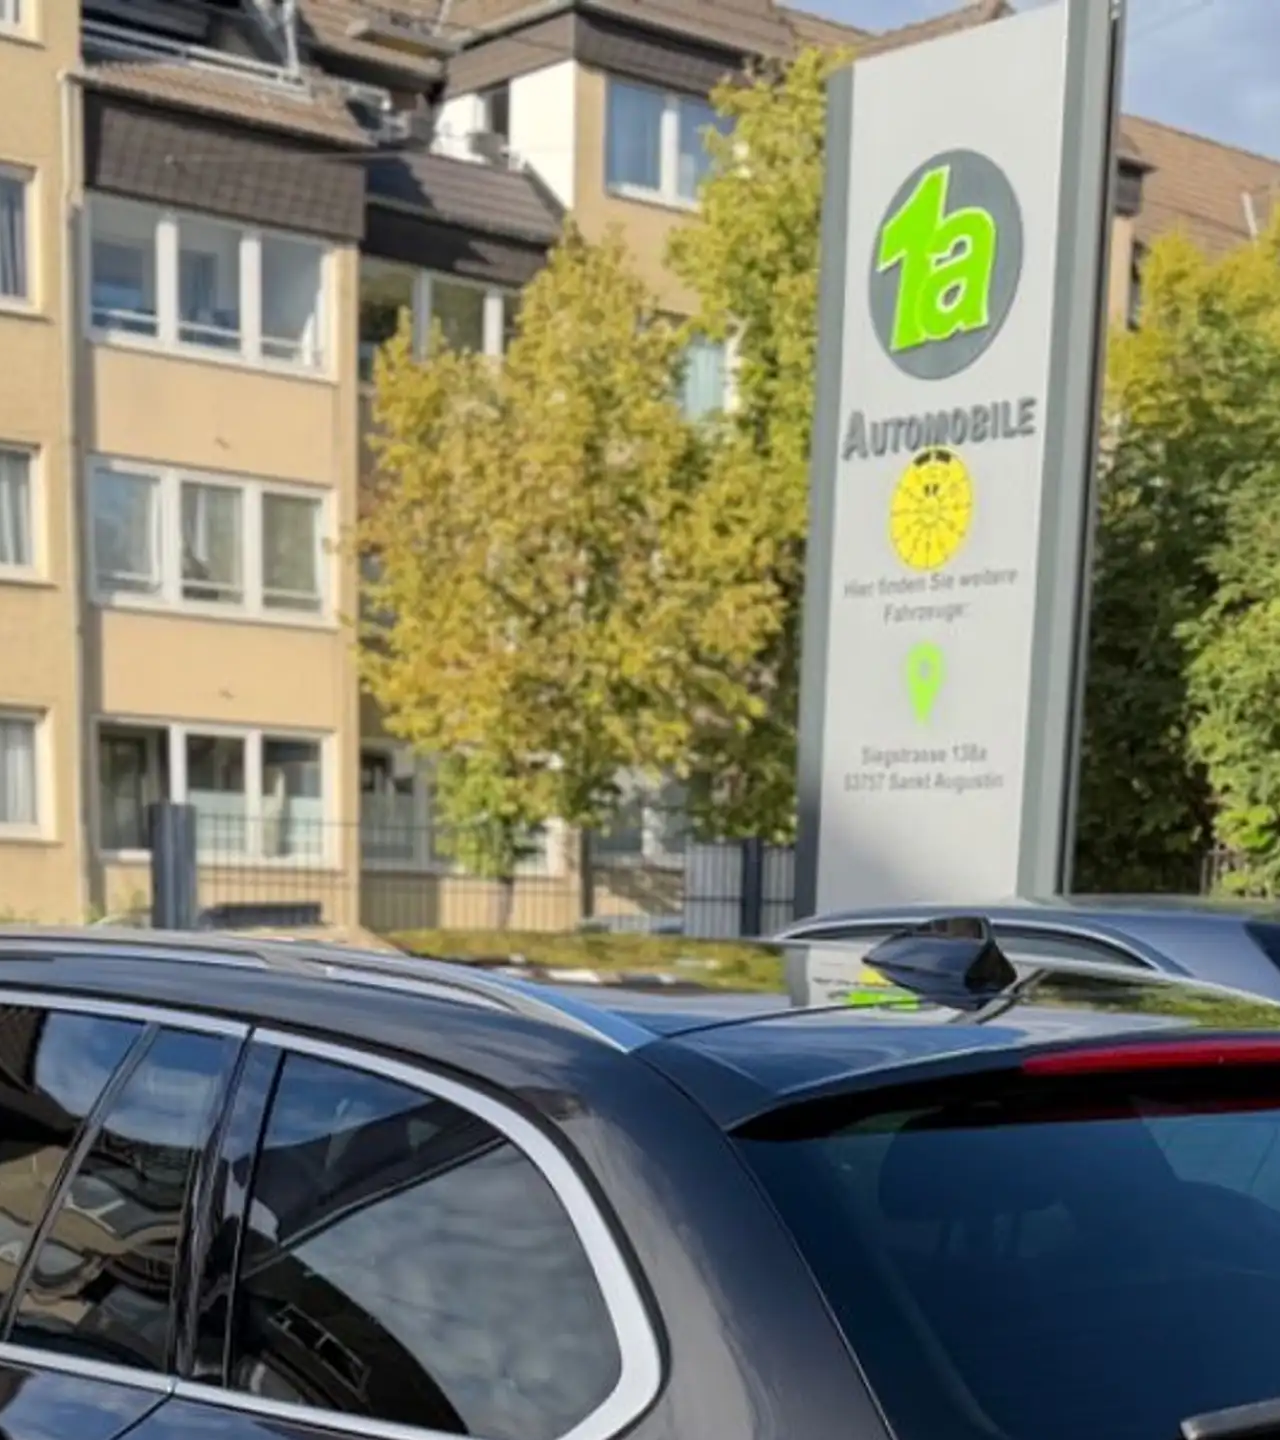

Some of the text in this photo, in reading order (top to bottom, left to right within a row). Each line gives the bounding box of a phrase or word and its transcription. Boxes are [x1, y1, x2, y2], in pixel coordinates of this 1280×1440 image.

[876, 164, 997, 352] 1a
[842, 397, 1038, 461] AUTOMOBILE
[843, 568, 1019, 598] Hier finden Sie weitere
[935, 772, 1005, 795] Augustin
